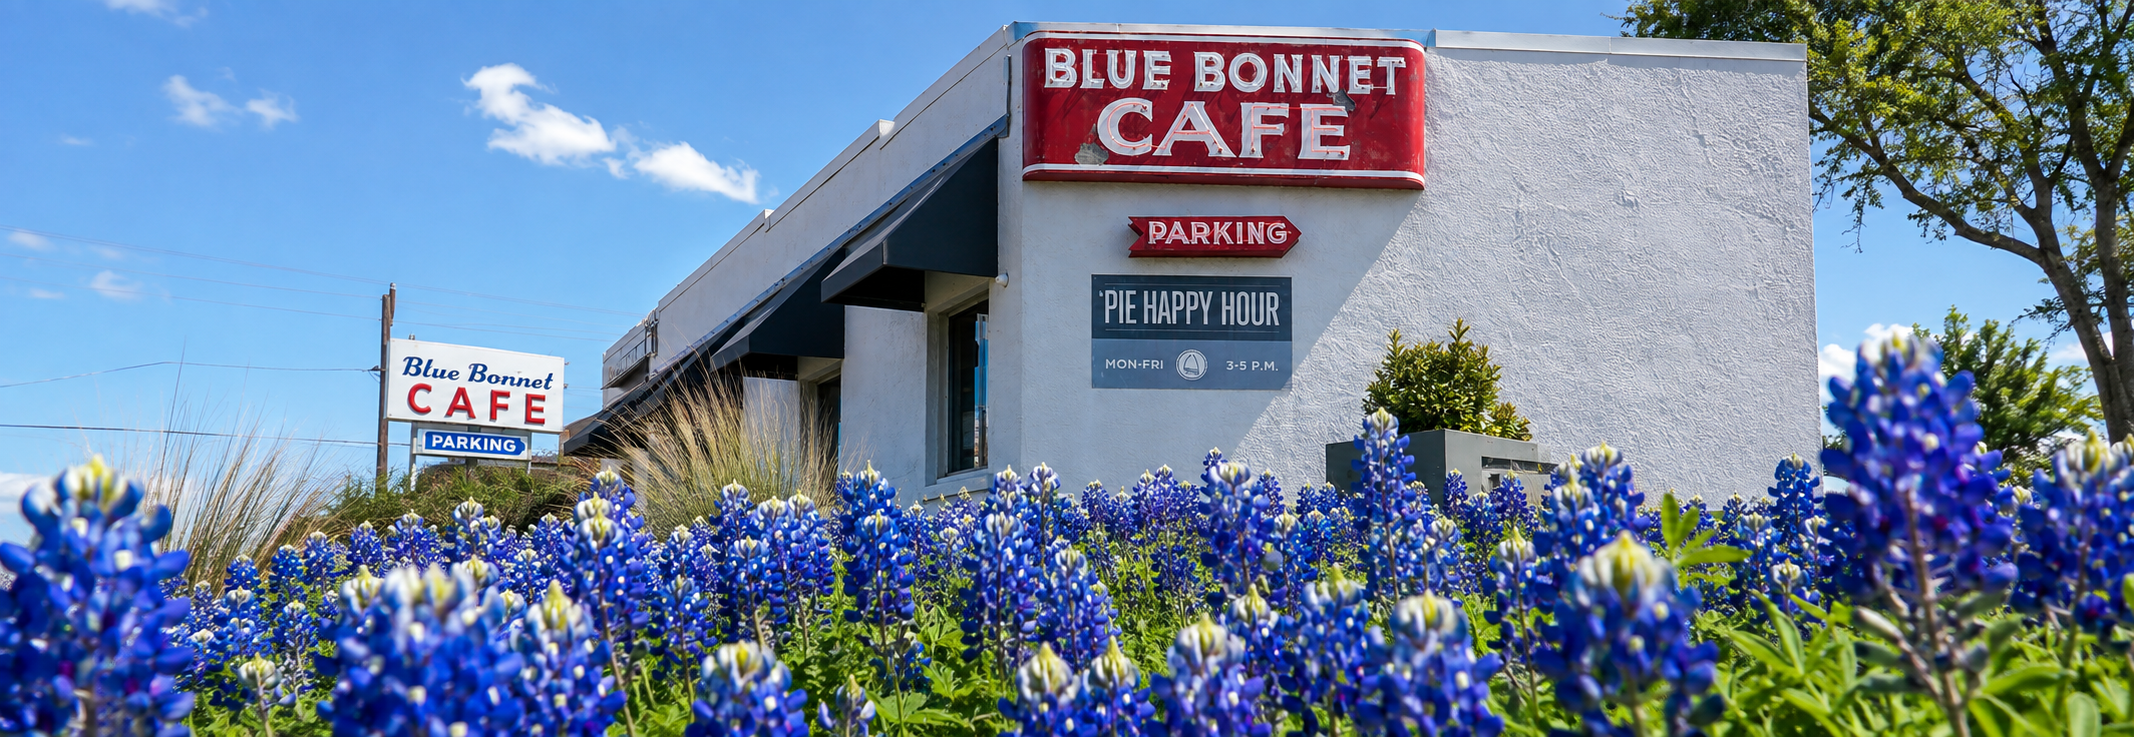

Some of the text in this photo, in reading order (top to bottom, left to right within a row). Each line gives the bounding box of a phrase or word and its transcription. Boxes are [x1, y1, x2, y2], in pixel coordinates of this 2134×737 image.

[1044, 47, 1406, 95] BLUE BONNET
[1097, 98, 1351, 161] CAFE
[1148, 221, 1288, 245] PARKING
[1143, 290, 1213, 325] HAPPY
[1221, 291, 1280, 326] HOUR
[402, 356, 554, 390] Blue Bonnet
[1105, 358, 1164, 370] MON-FRI
[1226, 360, 1279, 372] 3-5 P.M.
[407, 383, 546, 425] CAFE
[431, 434, 517, 453] PARKING
